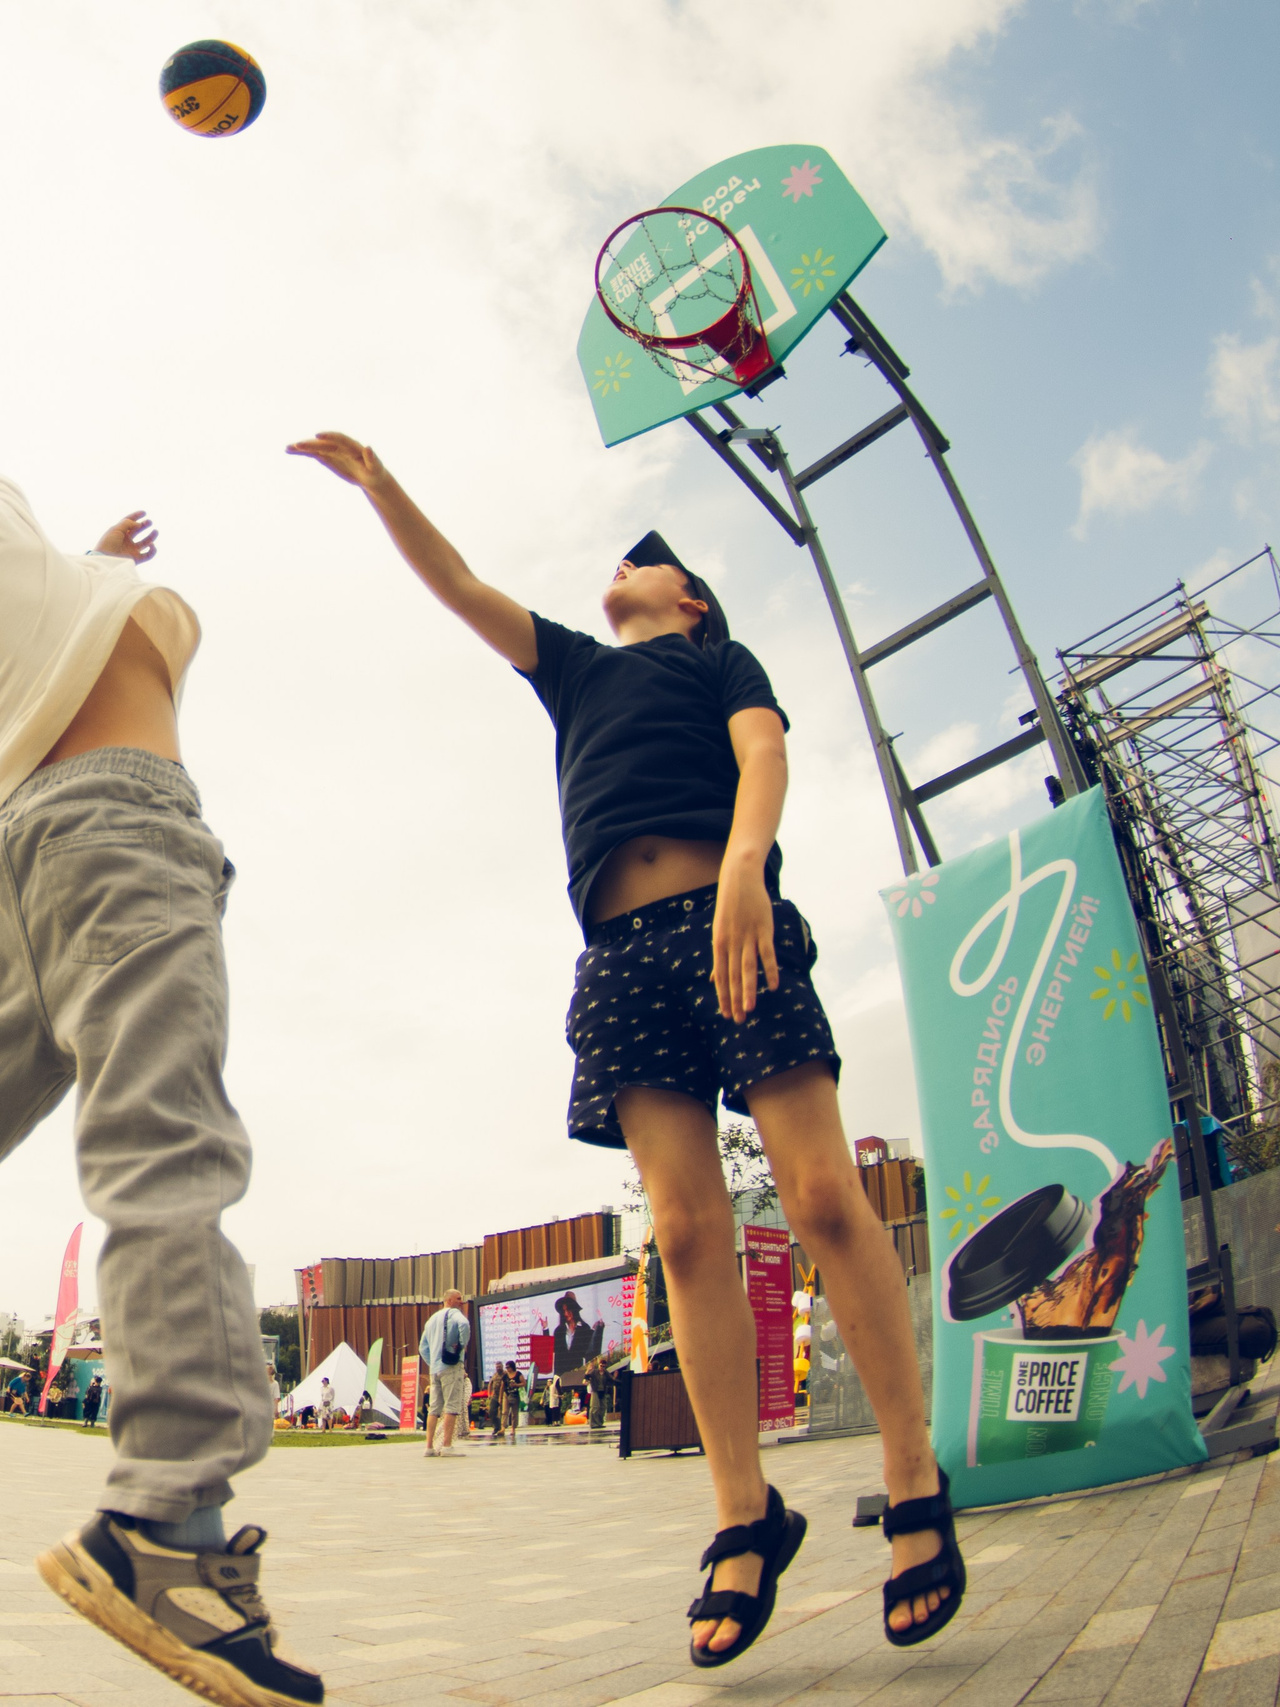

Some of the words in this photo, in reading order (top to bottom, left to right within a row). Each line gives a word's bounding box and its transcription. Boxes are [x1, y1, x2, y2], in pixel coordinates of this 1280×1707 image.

[677, 176, 743, 229] грод
[615, 264, 655, 303] COFFEE
[616, 252, 650, 286] PRICE
[1025, 894, 1101, 1066] ЭНЕРГИЕЙ!
[971, 975, 1019, 1155] ЗАРЯДИСЬ
[1017, 1361, 1029, 1386] ONE
[1028, 1360, 1079, 1387] PRICE
[1014, 1388, 1075, 1414] COFFEE
